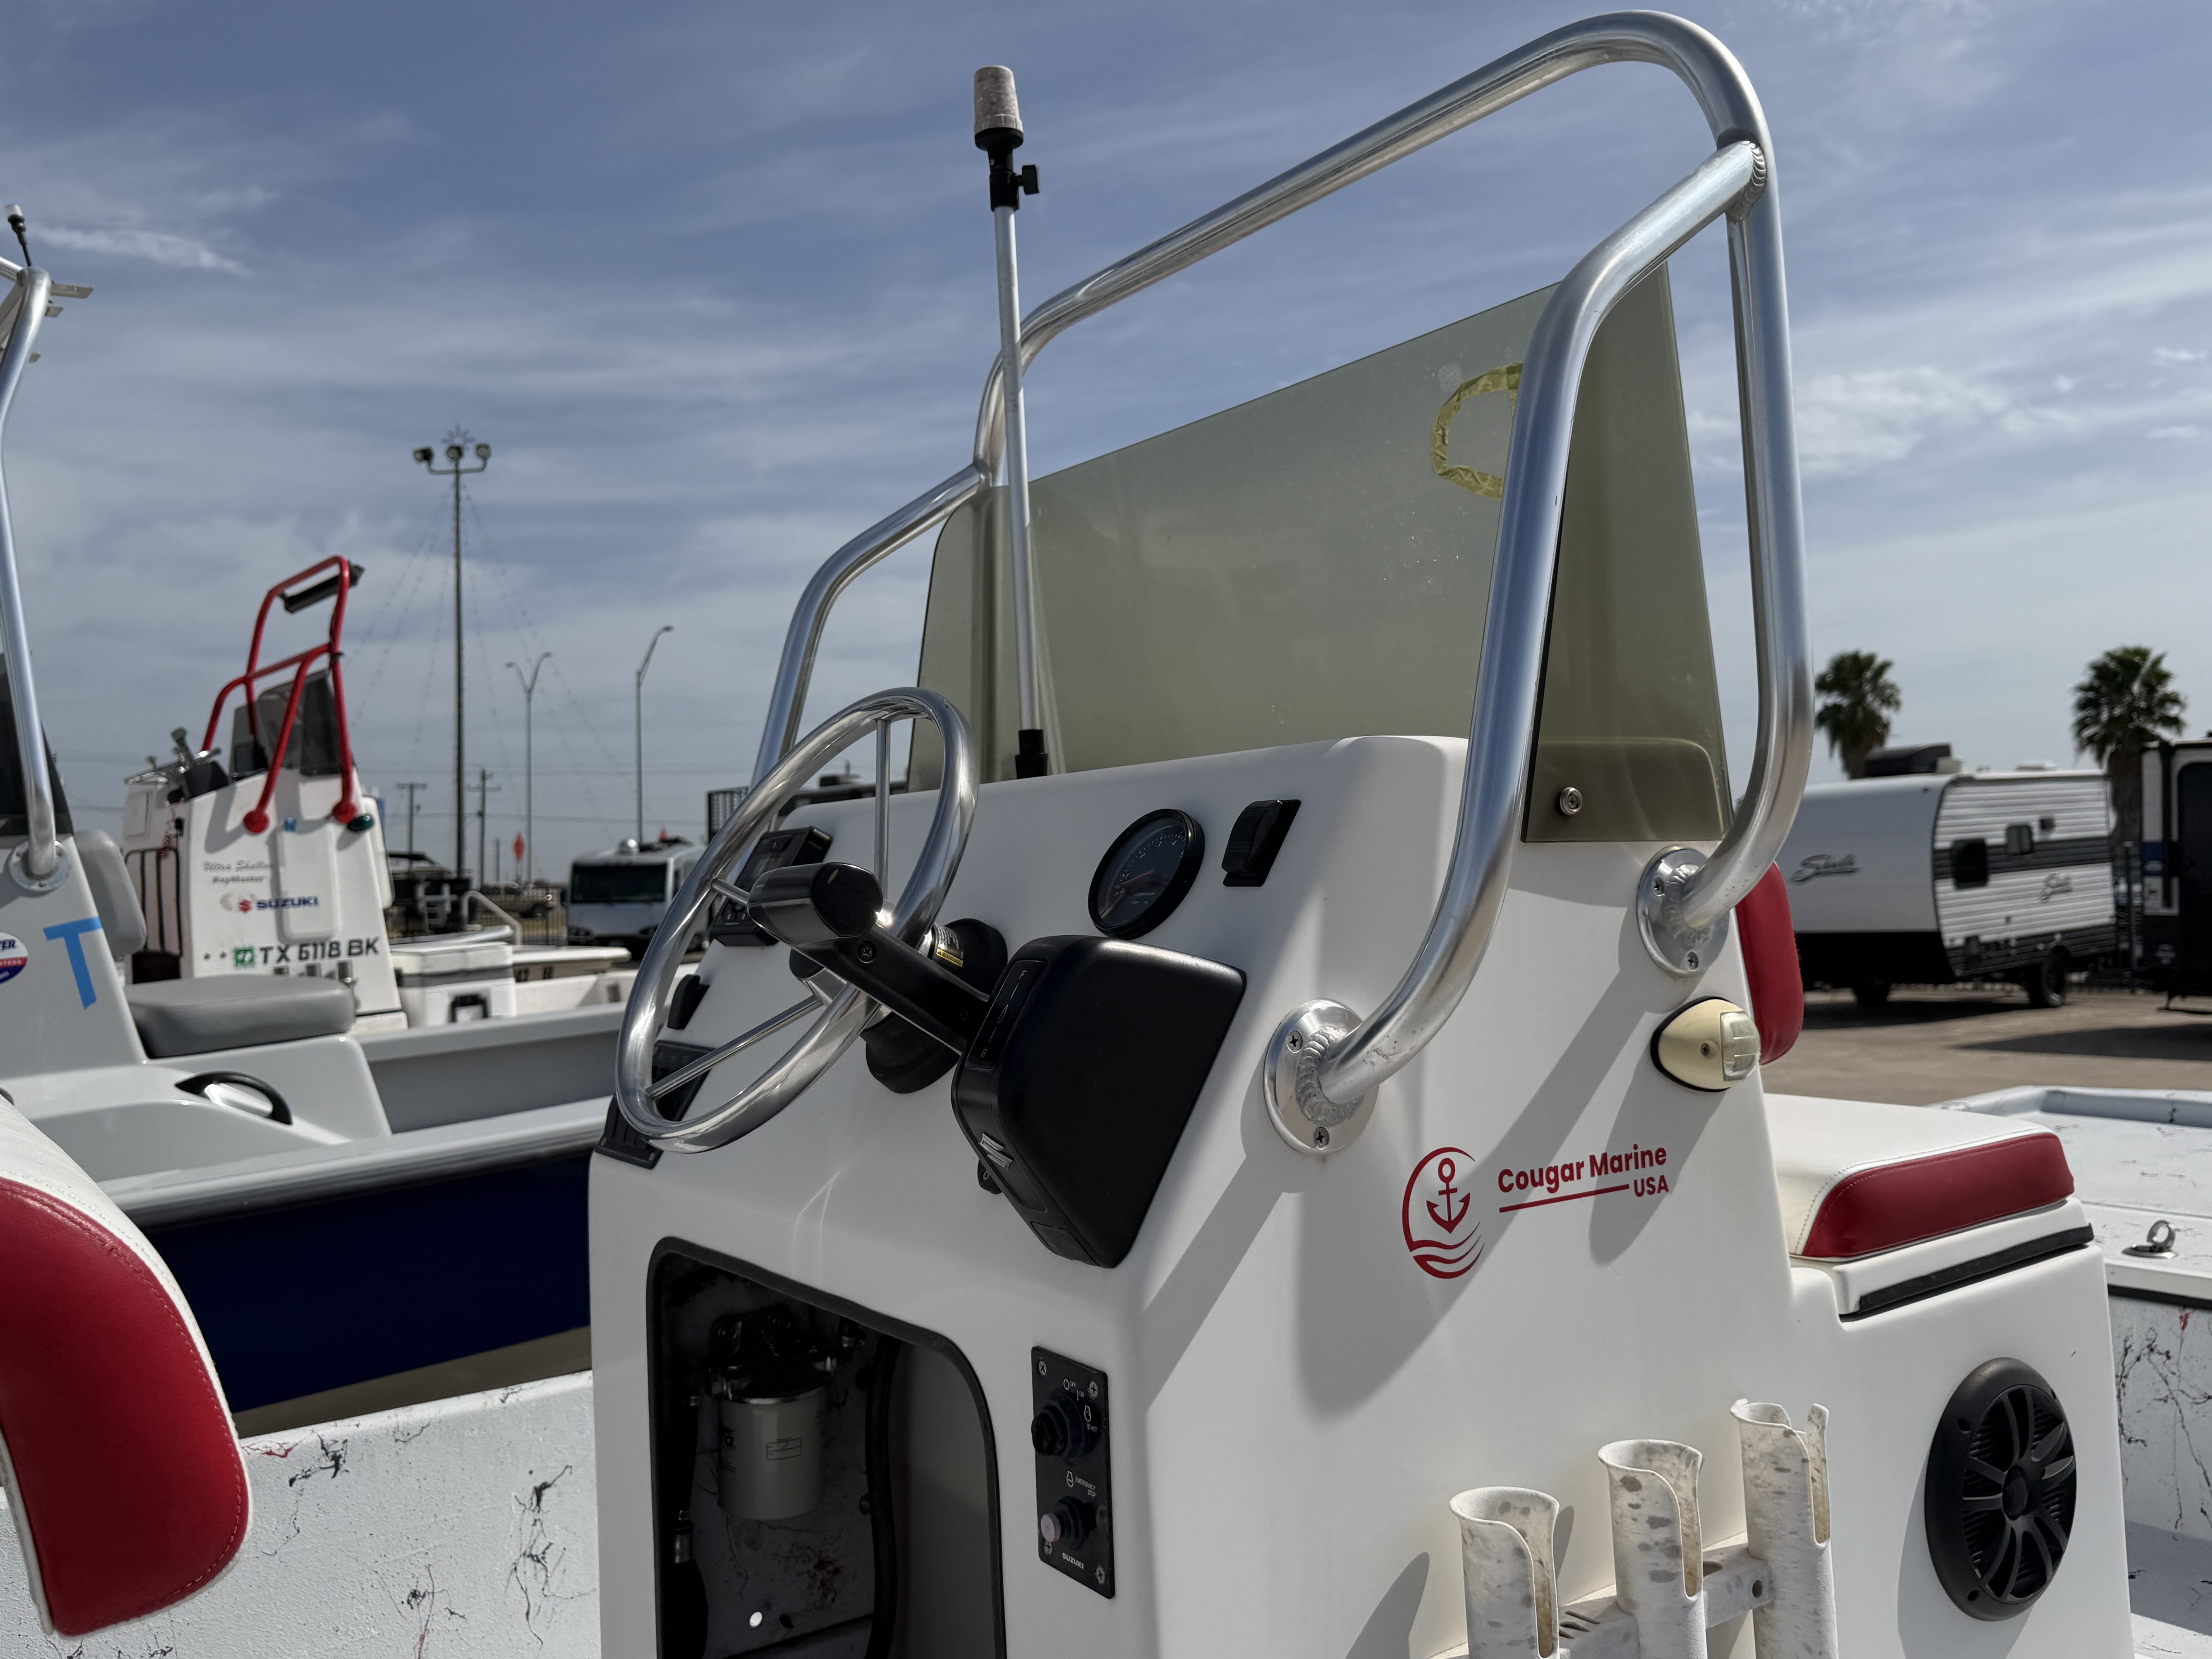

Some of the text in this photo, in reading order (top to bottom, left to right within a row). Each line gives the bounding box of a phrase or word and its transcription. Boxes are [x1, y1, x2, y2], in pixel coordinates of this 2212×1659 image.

[256, 895, 319, 909] SUZUKI
[259, 944, 290, 963] TX
[299, 940, 340, 961] 6118
[348, 937, 379, 957] BK
[1018, 970, 1027, 979] F
[980, 1048, 988, 1058] R
[1498, 1144, 1668, 1194] Cougar Marine
[1633, 1175, 1669, 1197] USA
[1075, 1476, 1096, 1491] EMERGENCY
[1062, 1552, 1084, 1570] SUZUKI
